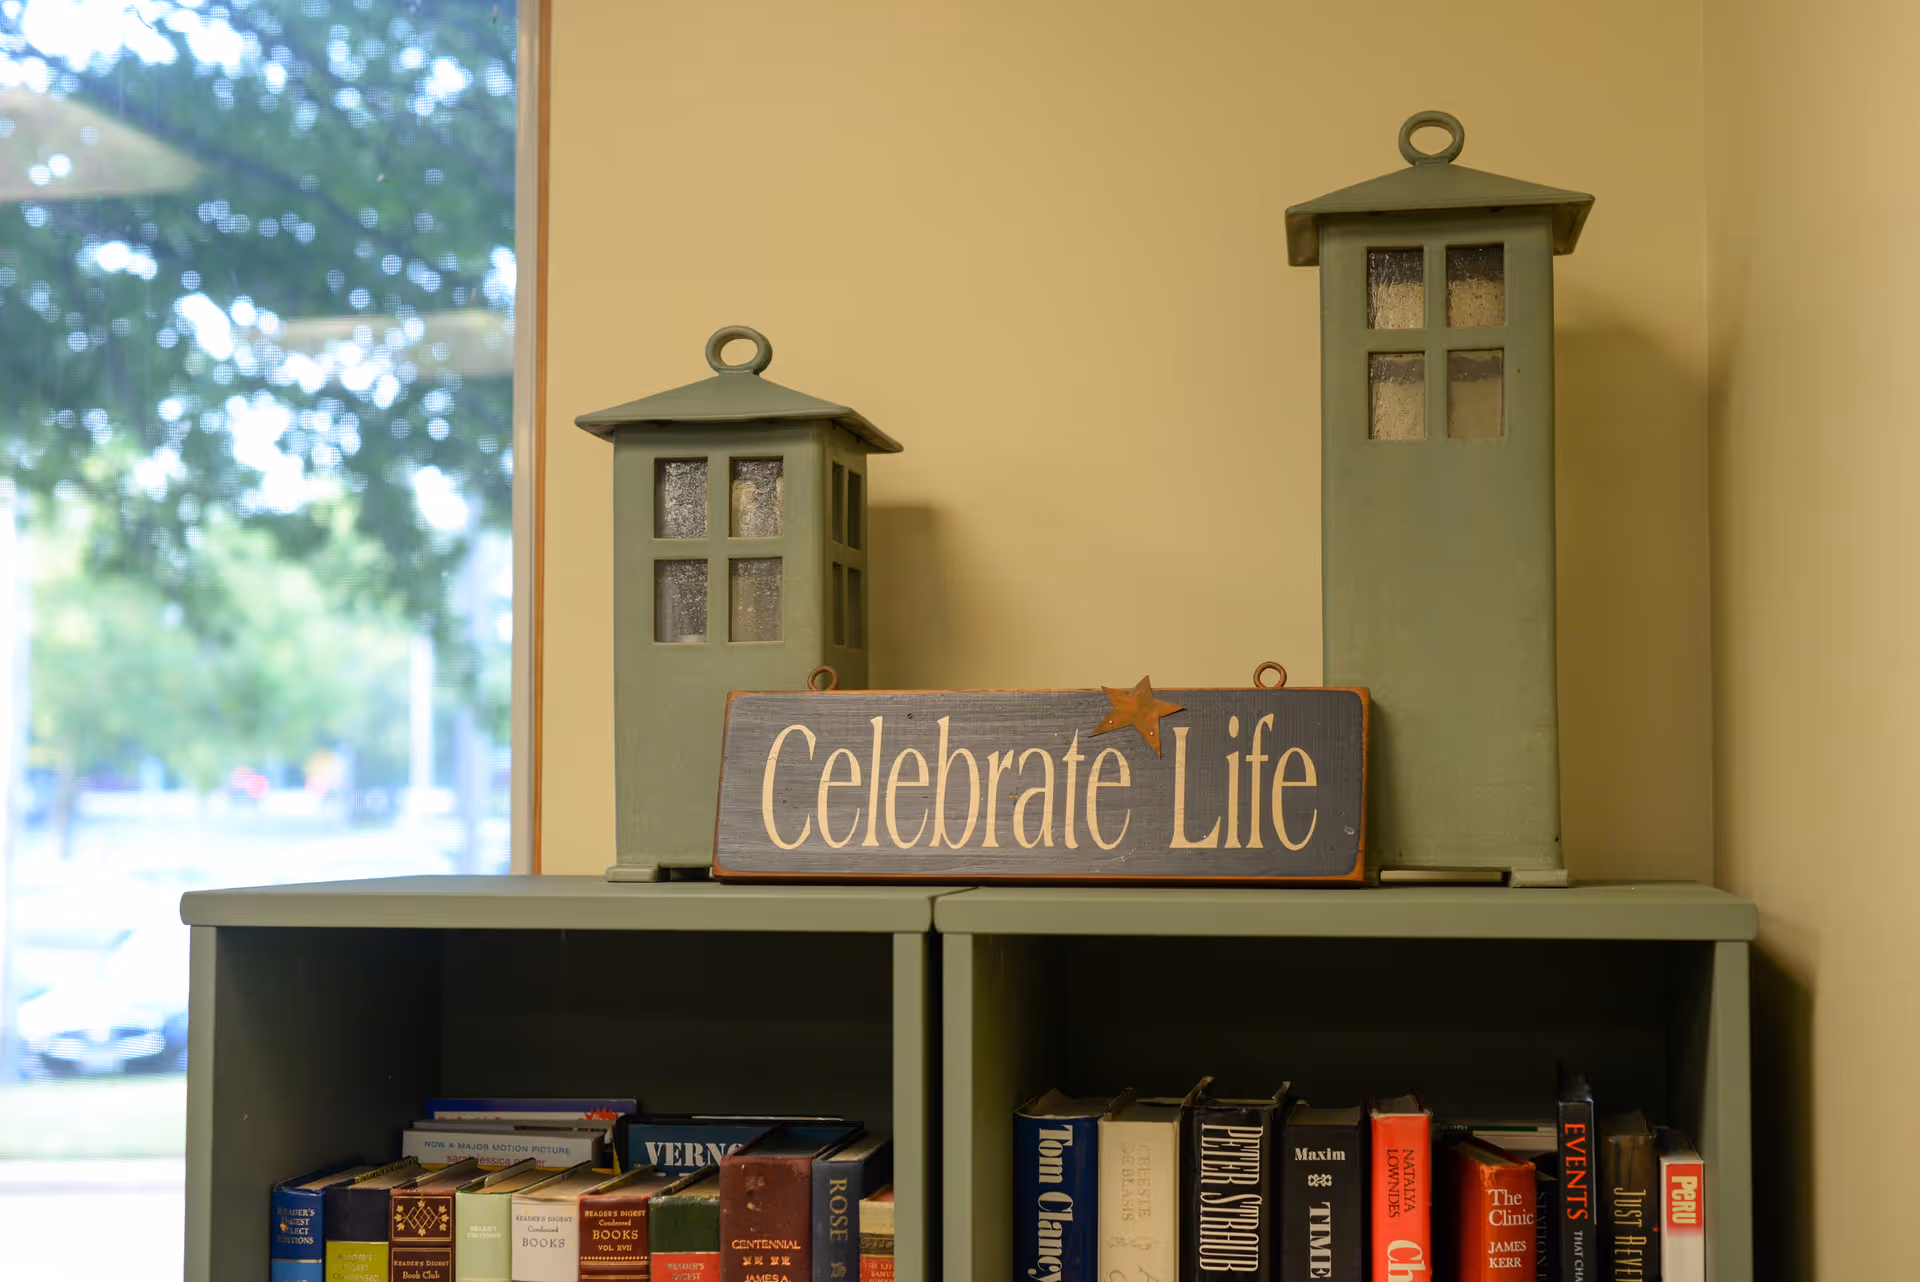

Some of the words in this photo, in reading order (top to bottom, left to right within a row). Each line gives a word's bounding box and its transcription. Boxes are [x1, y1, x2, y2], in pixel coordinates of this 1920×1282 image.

[761, 716, 1131, 851] Celebrate
[1169, 713, 1318, 851] Life
[424, 1140, 446, 1149] NOW
[448, 1142, 456, 1150] A
[457, 1142, 490, 1152] MAJOR
[492, 1143, 529, 1153] MOTION
[531, 1145, 571, 1155] PICTURE
[1038, 1124, 1073, 1184] Tom
[1121, 1142, 1134, 1165] DE
[1201, 1123, 1264, 1185] PETER
[1294, 1147, 1346, 1161] Maxim
[1564, 1123, 1589, 1220] EVENTS
[1137, 1144, 1151, 1218] CELESTE
[1387, 1149, 1401, 1219] LOWNDES
[1402, 1149, 1416, 1213] NATALYA
[1121, 1168, 1135, 1222] BLASIS
[1488, 1188, 1522, 1206] The
[277, 1207, 315, 1217] READER'S
[584, 1210, 618, 1218] READER'S
[829, 1178, 849, 1242] ROSE
[281, 1217, 310, 1226] DIGEST
[598, 1219, 632, 1227] Condensed
[1488, 1209, 1535, 1226] Clinic
[527, 1225, 559, 1234] Condensed
[592, 1230, 639, 1240] BOOKS
[1027, 1191, 1073, 1282] Clancy
[1199, 1192, 1263, 1272] STRAUB
[277, 1236, 314, 1245] EDITIONS
[521, 1237, 566, 1249] BOOKS
[731, 1239, 802, 1250] CENTENNIAL
[1309, 1201, 1332, 1279] TIME
[1488, 1240, 1527, 1254] JAMES
[1573, 1230, 1584, 1257] THAT
[597, 1244, 614, 1252] VOL.
[616, 1244, 633, 1252] XVII
[667, 1262, 705, 1271] READER'S
[1488, 1257, 1522, 1269] KERR
[402, 1270, 420, 1280] Book
[422, 1270, 440, 1280] Club
[672, 1272, 702, 1281] DIGEST
[744, 1273, 779, 1282] JAMES
